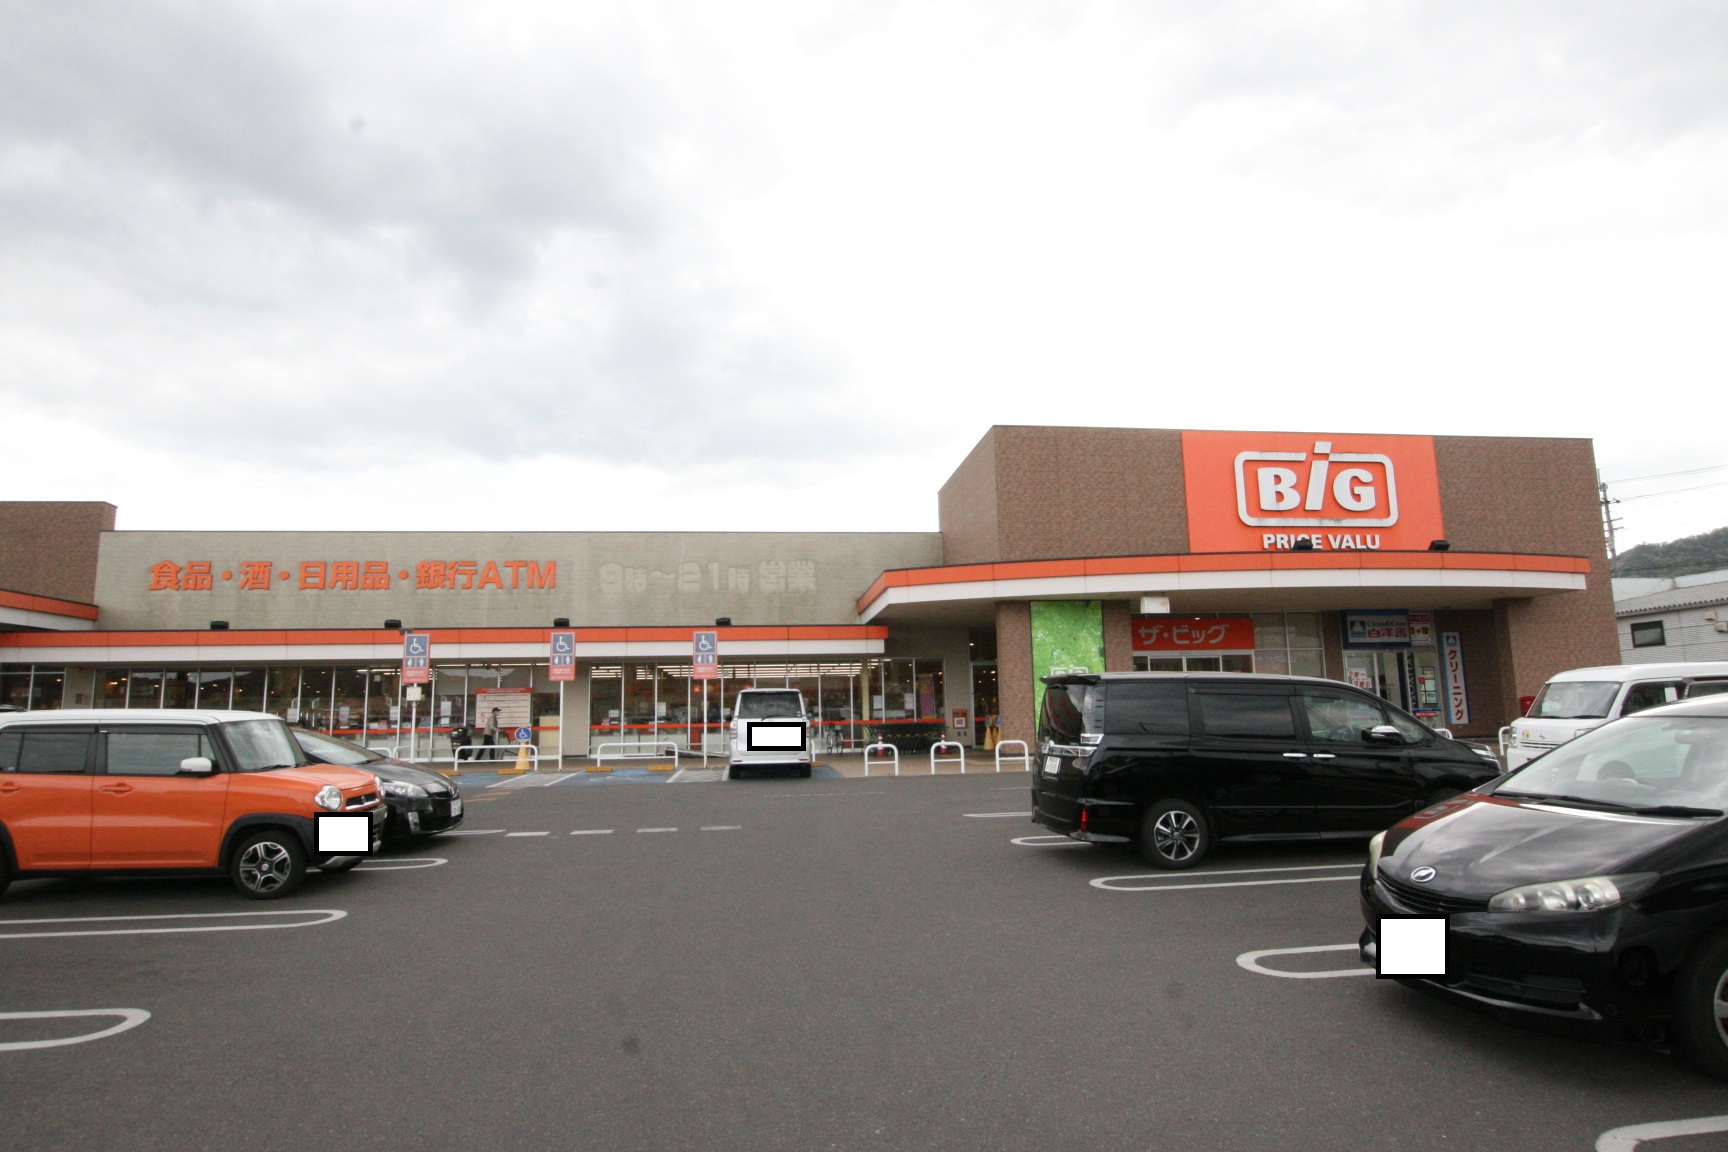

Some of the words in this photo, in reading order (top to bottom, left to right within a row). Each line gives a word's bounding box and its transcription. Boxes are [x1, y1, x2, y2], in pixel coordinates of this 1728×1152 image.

[1328, 534, 1380, 549] VALU
[1137, 624, 1229, 645] ザ・ビッグ
[1448, 649, 1464, 721] クリーニング
